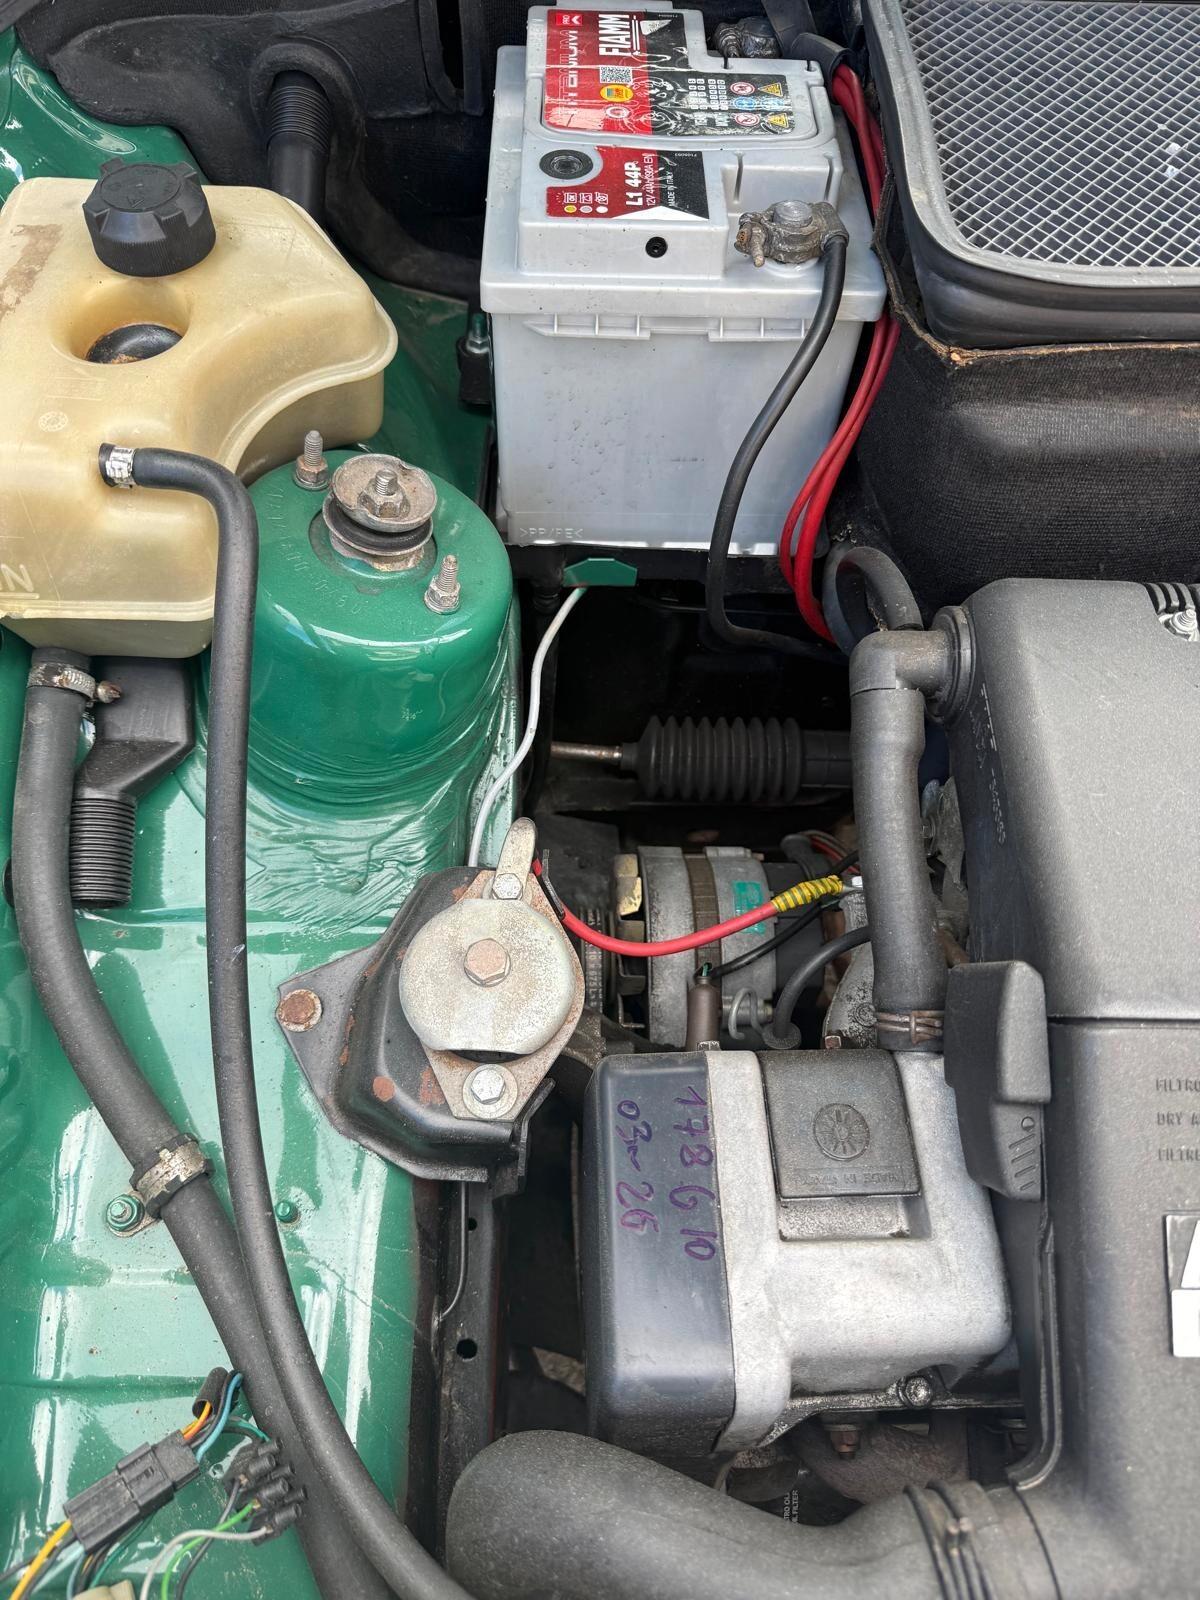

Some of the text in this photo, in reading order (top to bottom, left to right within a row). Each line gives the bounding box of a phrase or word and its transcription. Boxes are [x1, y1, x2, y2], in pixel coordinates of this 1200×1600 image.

[598, 13, 632, 56] FIAMM
[625, 192, 644, 206] L1
[646, 195, 656, 207] 12V
[667, 192, 676, 207] MADE
[1156, 1111, 1183, 1126] DRY
